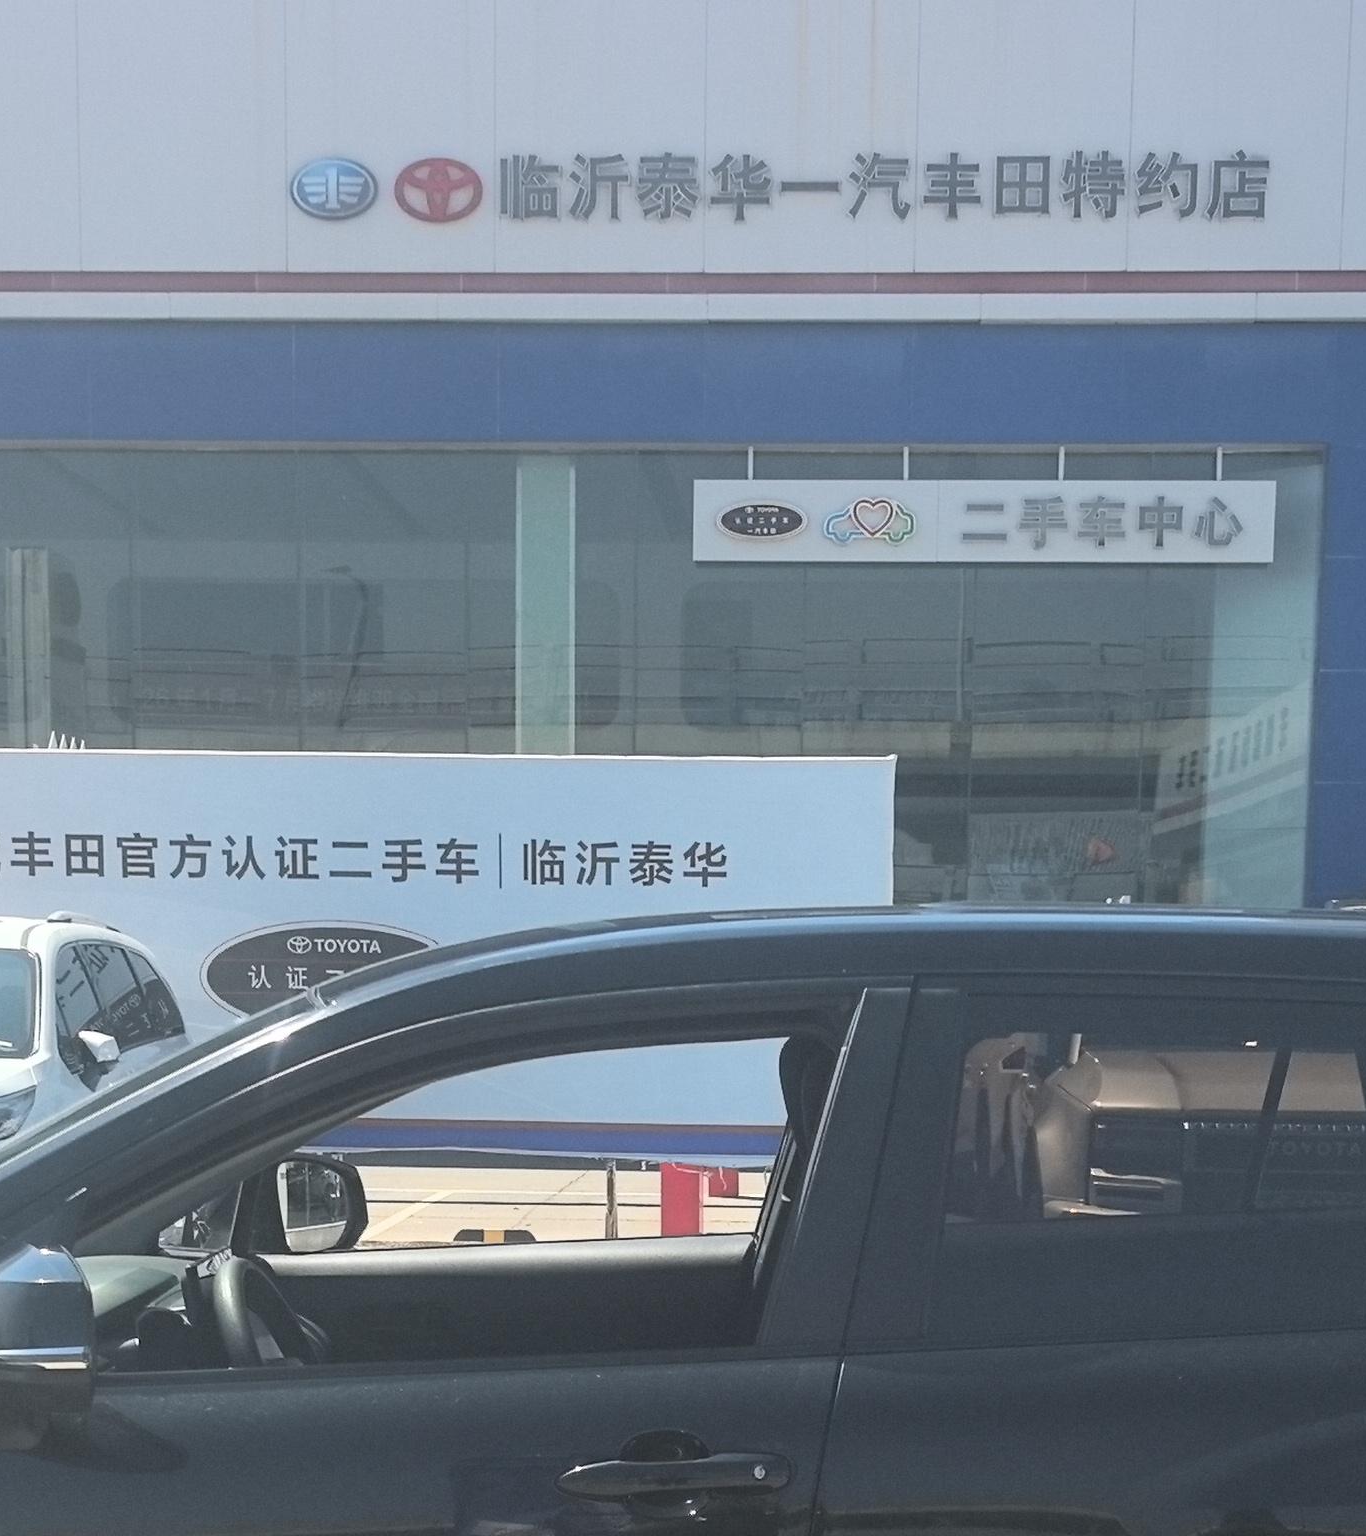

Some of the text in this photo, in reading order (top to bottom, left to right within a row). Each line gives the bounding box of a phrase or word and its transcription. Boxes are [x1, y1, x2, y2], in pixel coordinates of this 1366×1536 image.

[499, 151, 1272, 222] 临沂泰华一汽丰田特约店
[962, 494, 1244, 551] 二手车中心
[521, 837, 729, 891] 临沂泰华
[313, 938, 382, 955] TOYOTA
